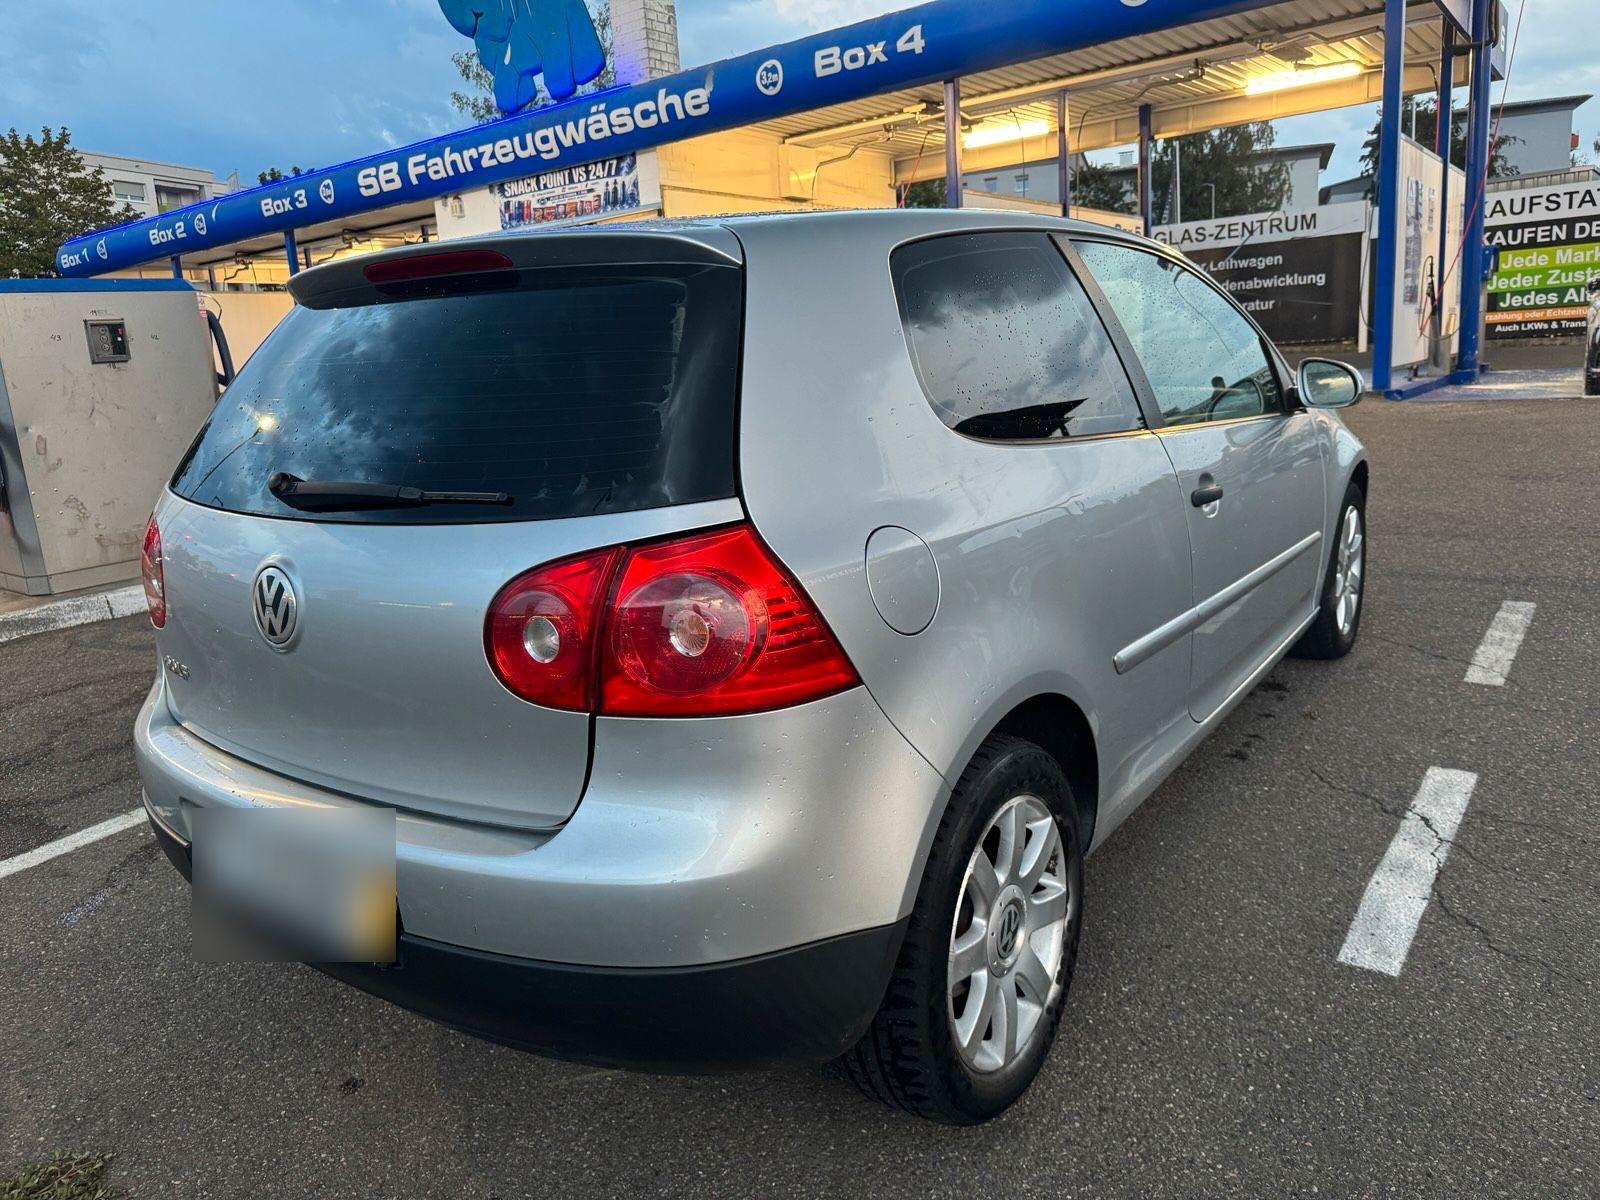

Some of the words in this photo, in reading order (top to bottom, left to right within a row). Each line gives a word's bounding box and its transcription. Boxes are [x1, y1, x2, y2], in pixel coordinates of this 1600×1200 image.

[814, 39, 889, 79] Box
[896, 24, 926, 55] 4
[357, 161, 403, 198] SB
[407, 87, 711, 186] Fahrzeugwäsche
[503, 176, 538, 198] SNACK
[540, 169, 571, 190] POINT
[571, 164, 587, 182] VS
[588, 159, 618, 180] 24/7
[260, 196, 293, 217] Box
[291, 188, 308, 209] 3
[149, 228, 176, 246] Box
[175, 221, 188, 239] 2
[1154, 212, 1318, 246] GLAS-ZENTRUM
[60, 252, 82, 270] Box
[82, 249, 90, 263] 1
[1209, 255, 1283, 270] Leihwagen
[1501, 252, 1549, 269] Jede
[1487, 272, 1543, 290] Jeder
[1499, 291, 1559, 308] Jedes
[1524, 310, 1545, 319] oder
[1495, 323, 1519, 333] Auch
[1521, 322, 1549, 331] LKWs
[1551, 321, 1559, 329] &
